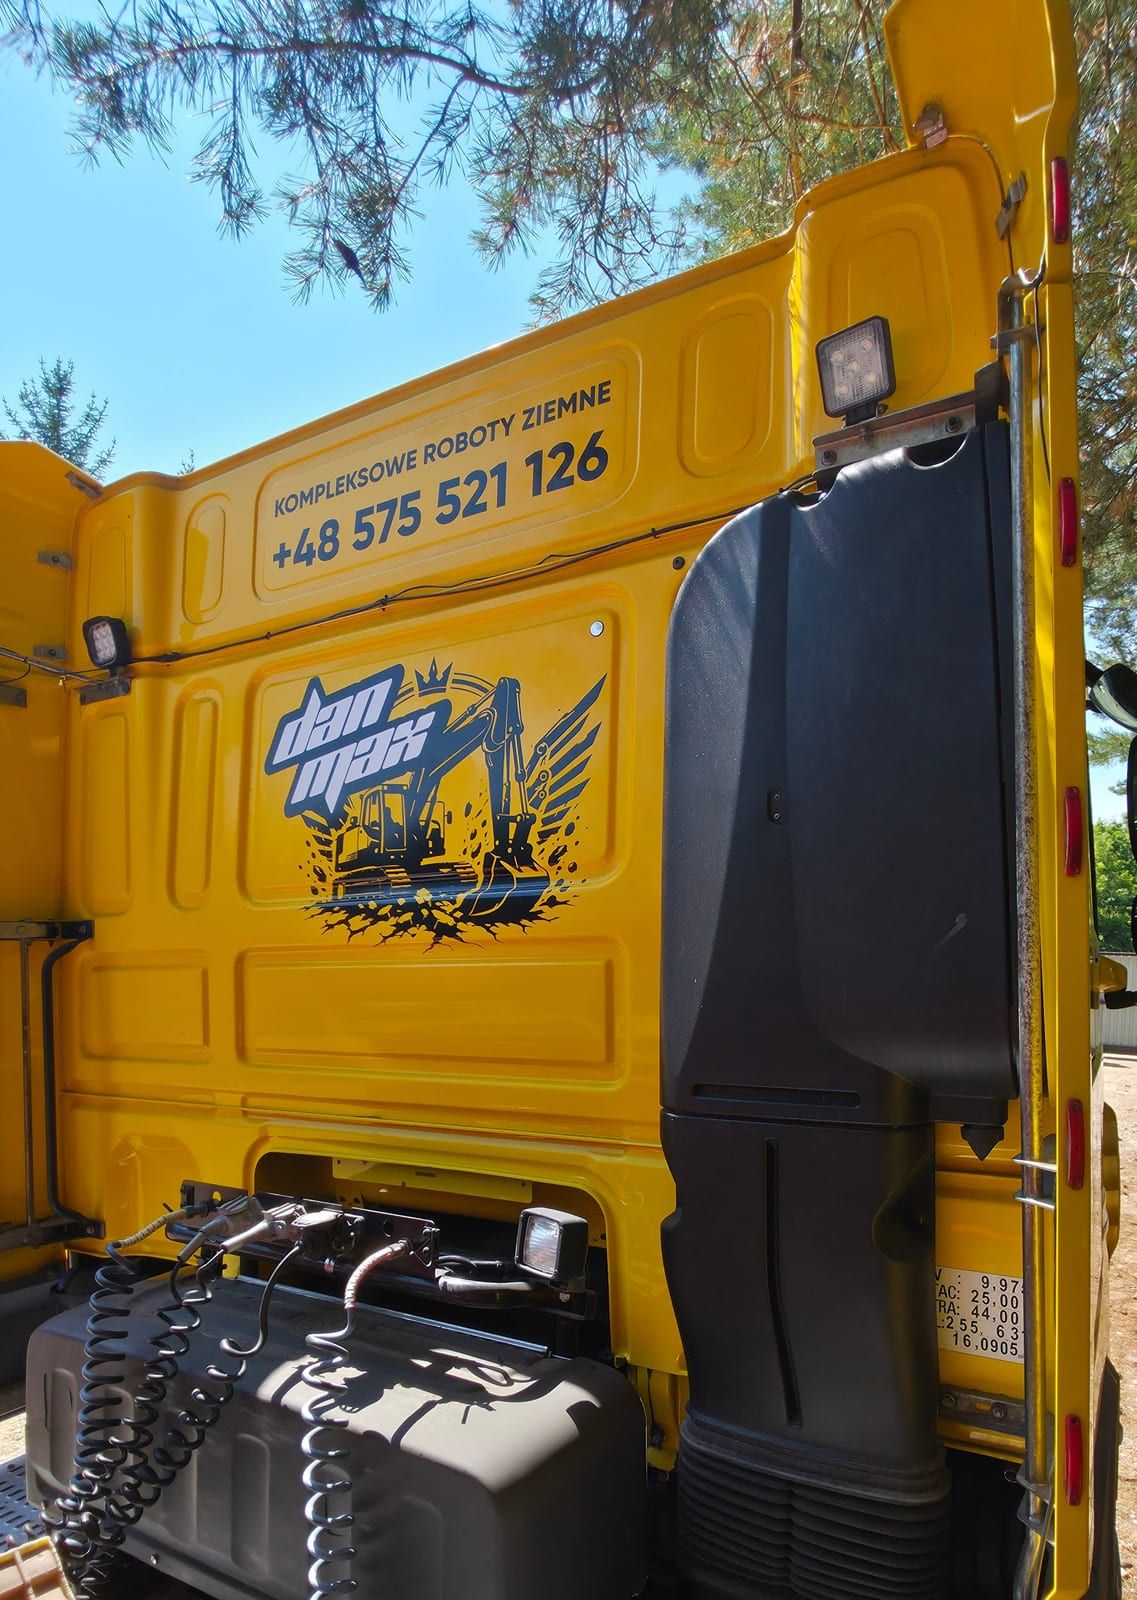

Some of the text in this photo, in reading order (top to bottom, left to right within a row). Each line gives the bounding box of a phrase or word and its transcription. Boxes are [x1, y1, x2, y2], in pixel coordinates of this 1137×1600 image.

[274, 380, 612, 518] KOMPLEKSOWE ROBOTY ZIEMNE
[272, 430, 609, 569] +48 575 521 126
[936, 1283, 1018, 1309] AC: 25,00
[981, 1275, 1024, 1294] 9,97
[936, 1299, 1018, 1325] RA: 44,00
